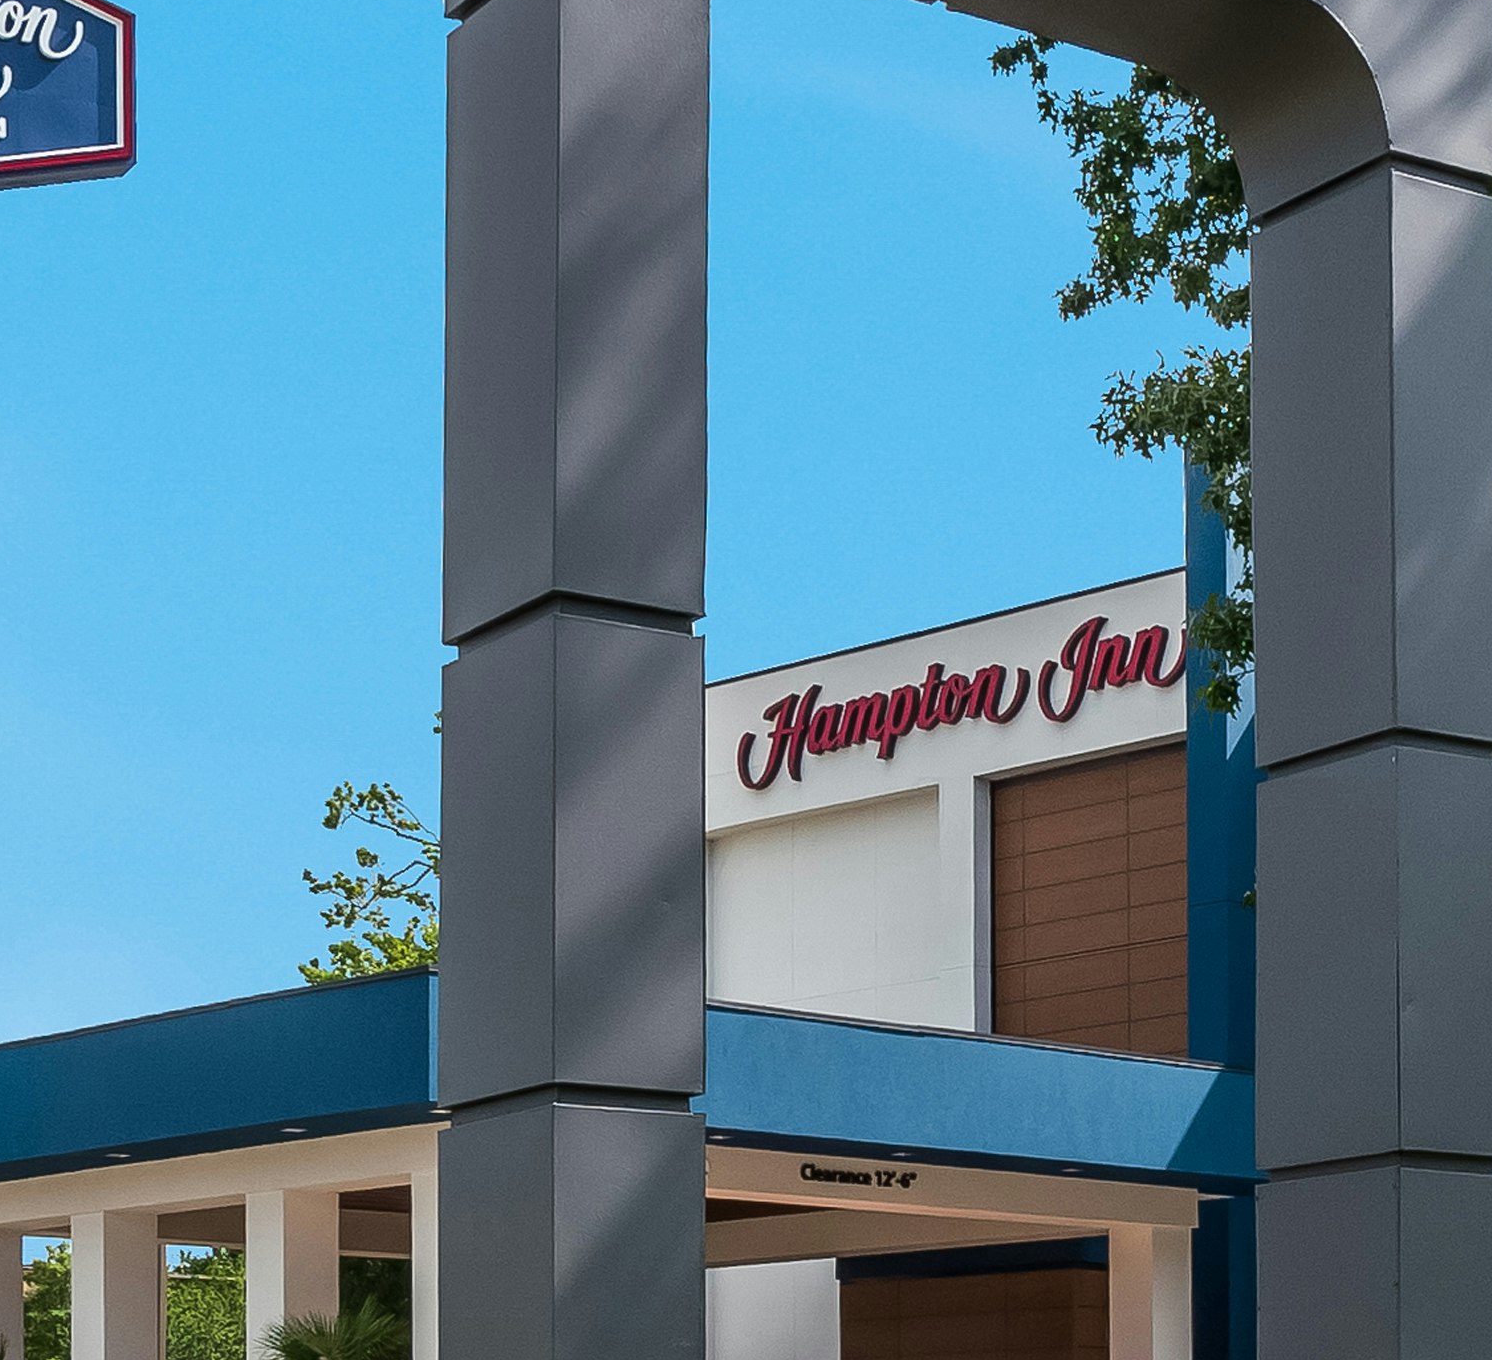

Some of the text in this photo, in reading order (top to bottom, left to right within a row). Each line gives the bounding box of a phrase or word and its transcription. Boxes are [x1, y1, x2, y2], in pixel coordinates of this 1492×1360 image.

[737, 616, 1187, 789] Hampton Inn
[801, 1163, 872, 1186] Clearance
